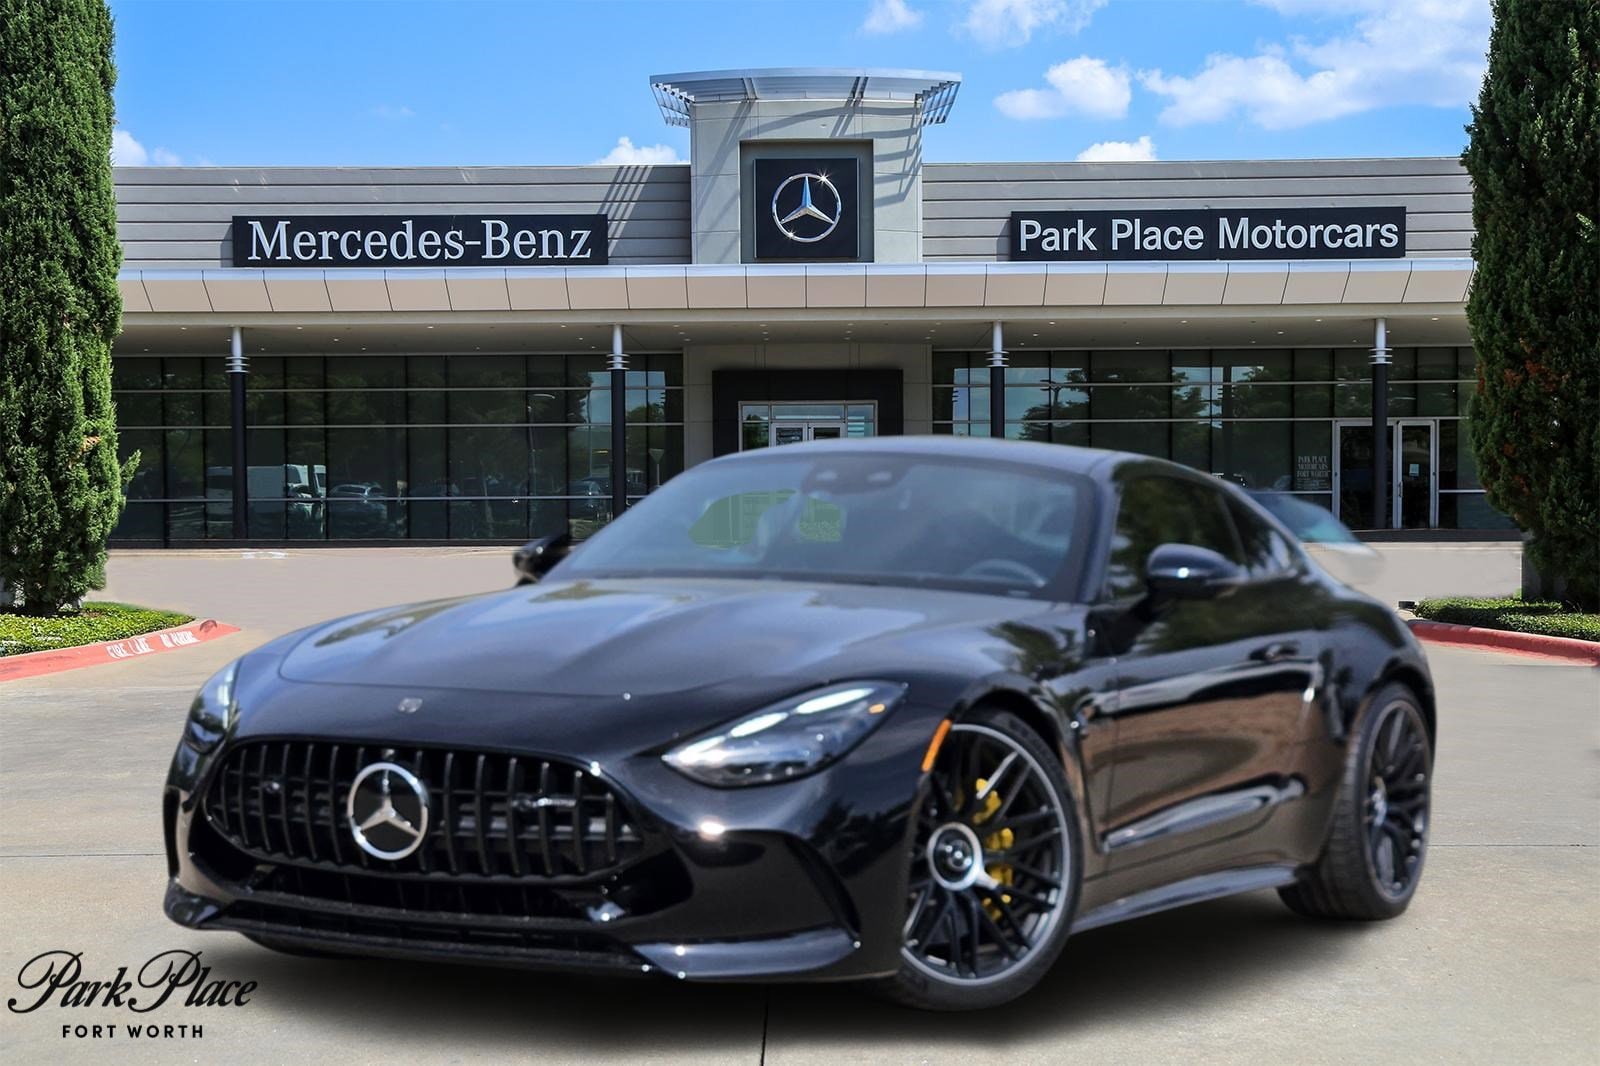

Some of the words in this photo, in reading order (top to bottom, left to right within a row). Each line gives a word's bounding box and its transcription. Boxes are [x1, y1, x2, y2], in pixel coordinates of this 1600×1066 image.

[248, 220, 591, 260] Mercedes-Benz
[1020, 219, 1097, 251] Park
[1111, 218, 1203, 250] Place
[1218, 217, 1398, 249] Motorcars
